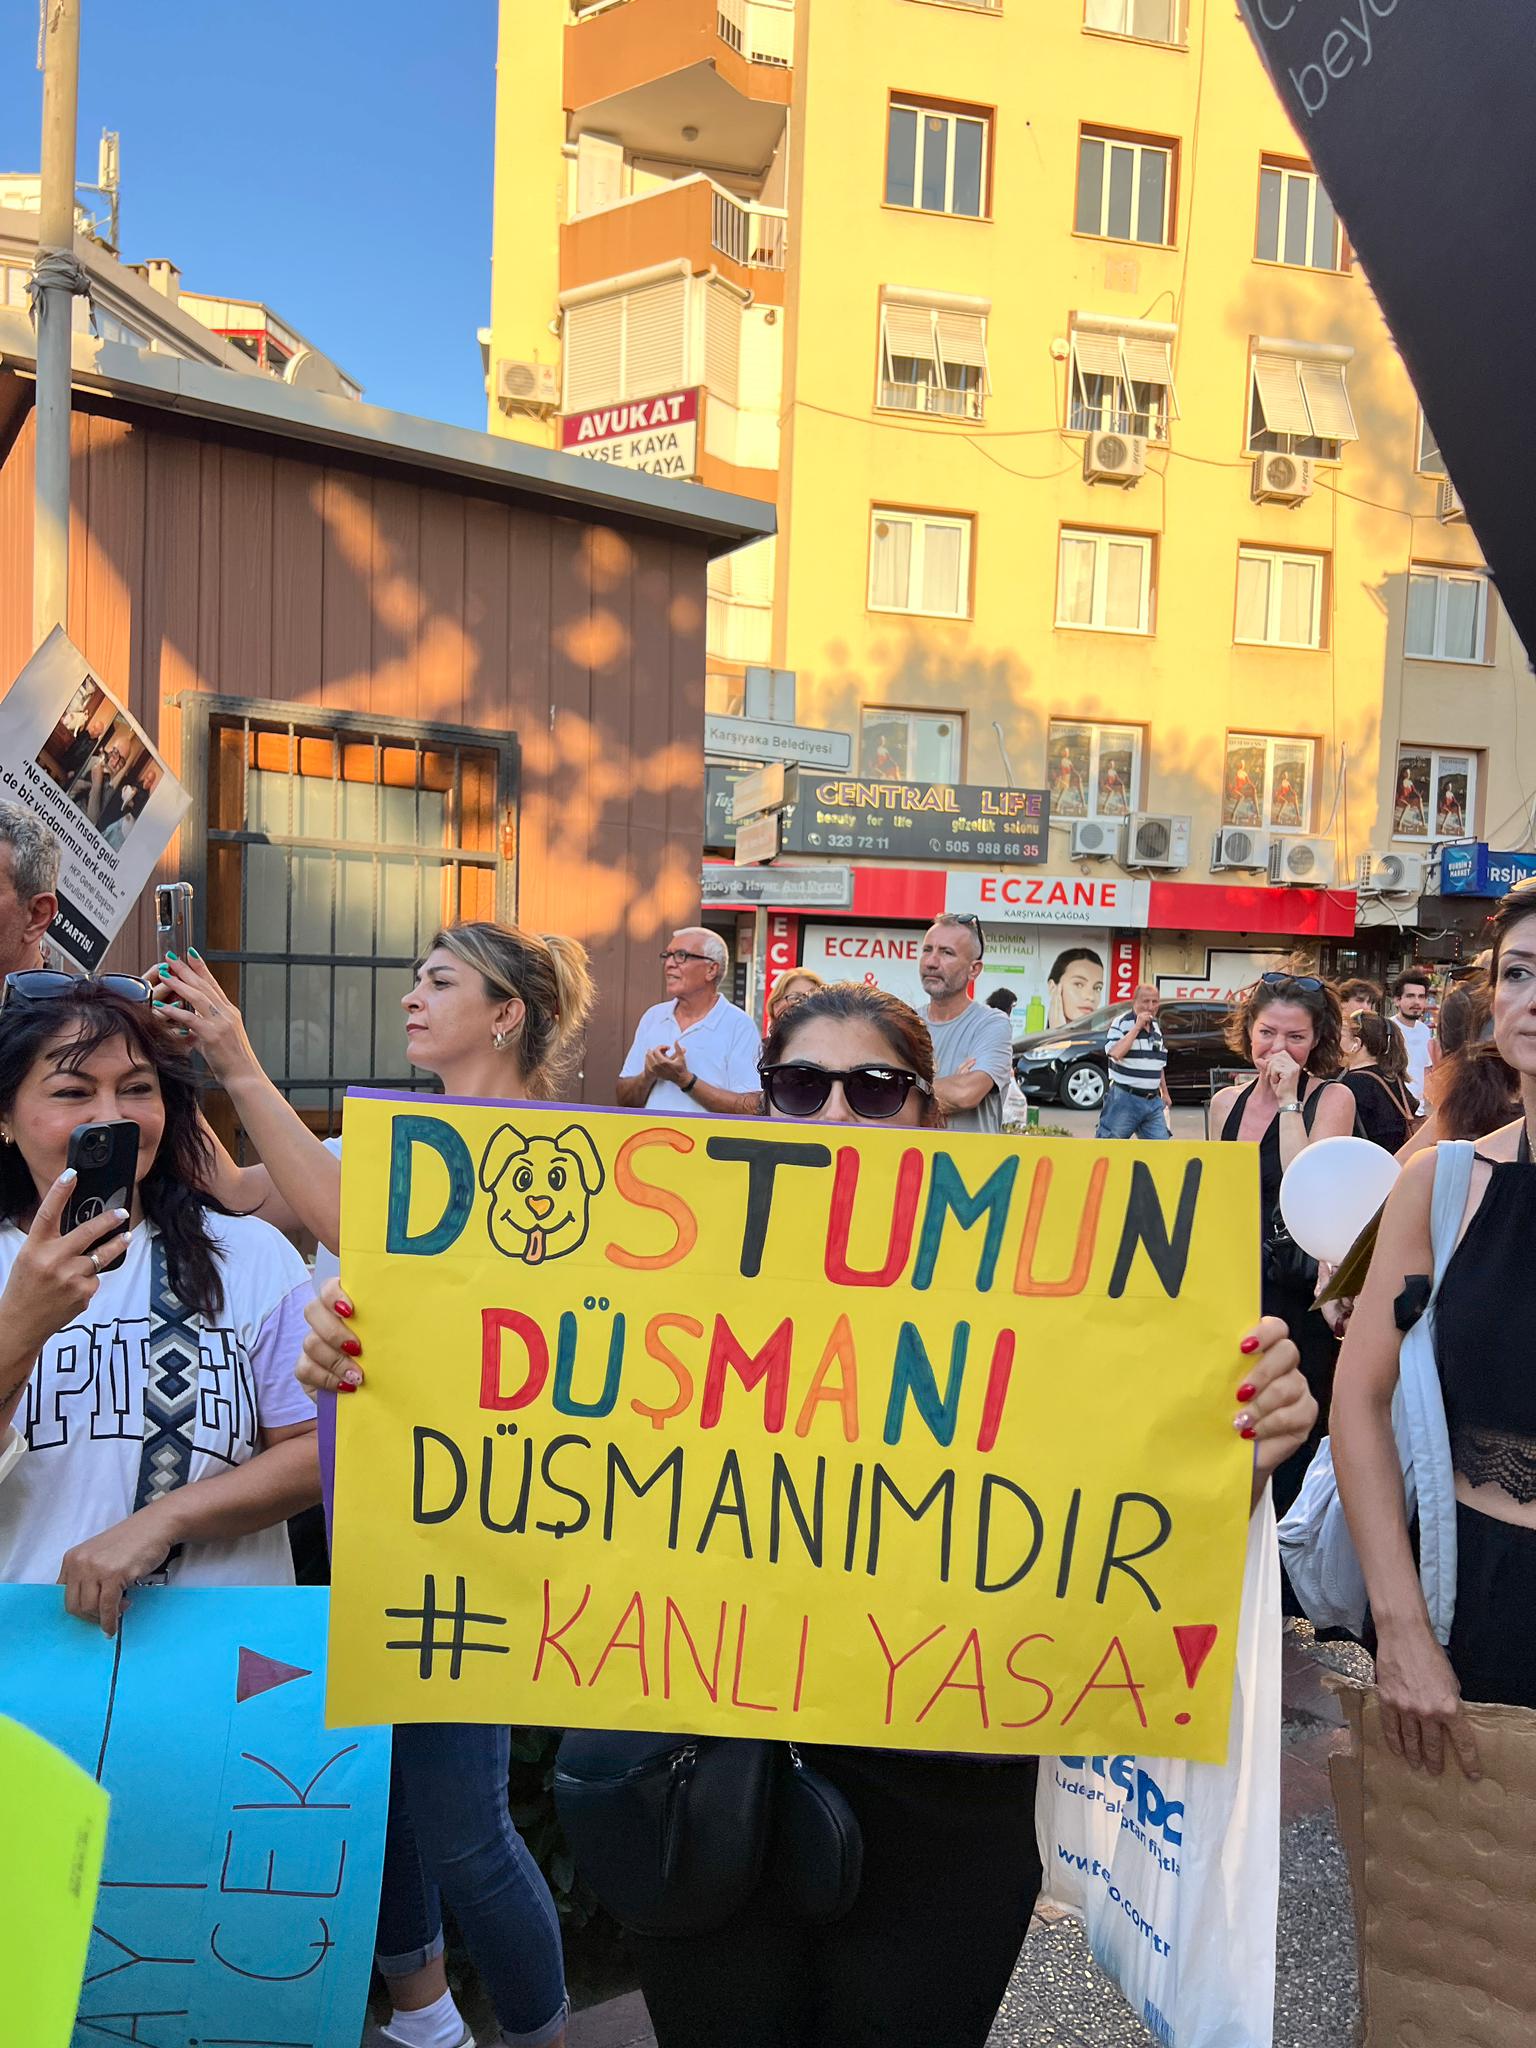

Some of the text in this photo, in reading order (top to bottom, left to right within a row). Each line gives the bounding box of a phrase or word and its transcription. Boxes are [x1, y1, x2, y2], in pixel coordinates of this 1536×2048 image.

[577, 394, 686, 441] AVUKAT
[630, 432, 679, 458] KAYA
[710, 726, 833, 755] Karşıyaka Belediyesi
[816, 781, 961, 813] CENTRAL
[981, 790, 1043, 817] LIFE
[3, 769, 19, 790] de
[17, 784, 35, 807] biz
[34, 802, 83, 859] vicdanımızı
[82, 850, 101, 877] terk
[40, 780, 77, 825] zalimler
[75, 815, 100, 854] insafa
[99, 846, 120, 871] geldi
[816, 810, 857, 828] beauty
[866, 814, 884, 827] for
[1003, 820, 1040, 835] salonu
[828, 834, 1039, 857] 323 72 11 505 988 66 35
[63, 876, 86, 902] Nurullah
[69, 864, 82, 879] HKP
[79, 874, 97, 894] Genel
[980, 878, 1117, 908] ECZANE
[1004, 908, 1091, 922] KARŞIYAKA ÇAĞDAŞ
[61, 918, 95, 954] PARTİSİ
[824, 937, 918, 960] ECZANE
[1013, 946, 1034, 956] HALİ
[864, 972, 878, 988] &
[479, 1296, 1016, 1452] DÜŞMANI
[412, 1423, 1173, 1611] DÜŞMANIMDIR
